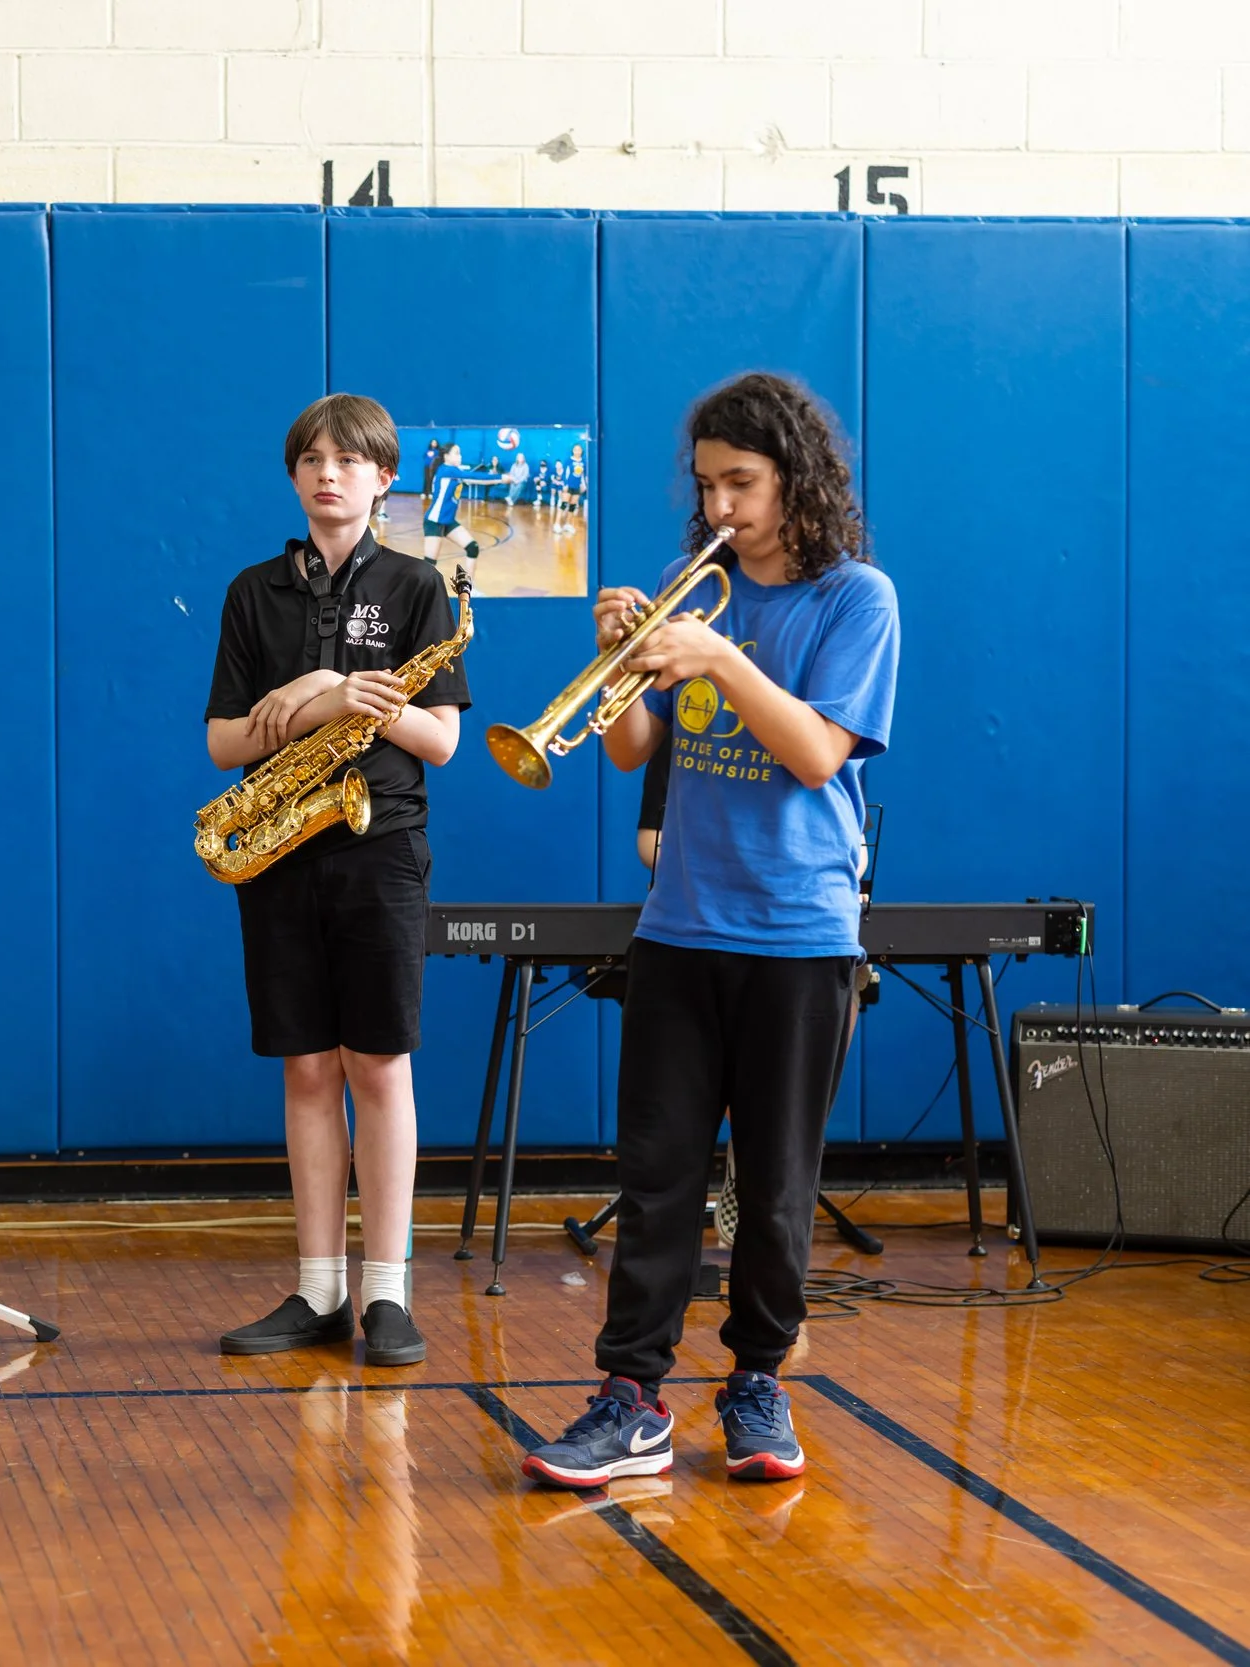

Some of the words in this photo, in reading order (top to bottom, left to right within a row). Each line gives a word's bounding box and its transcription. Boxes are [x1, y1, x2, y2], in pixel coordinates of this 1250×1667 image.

[322, 159, 393, 207] 14
[833, 165, 909, 215] 15
[350, 603, 381, 619] MS
[366, 621, 389, 636] 50
[345, 637, 363, 645] JAZZ
[365, 638, 386, 648] BAND
[719, 747, 743, 760] OF
[447, 922, 497, 941] KORG
[511, 923, 535, 941] D1
[1027, 1055, 1074, 1090] Fender
